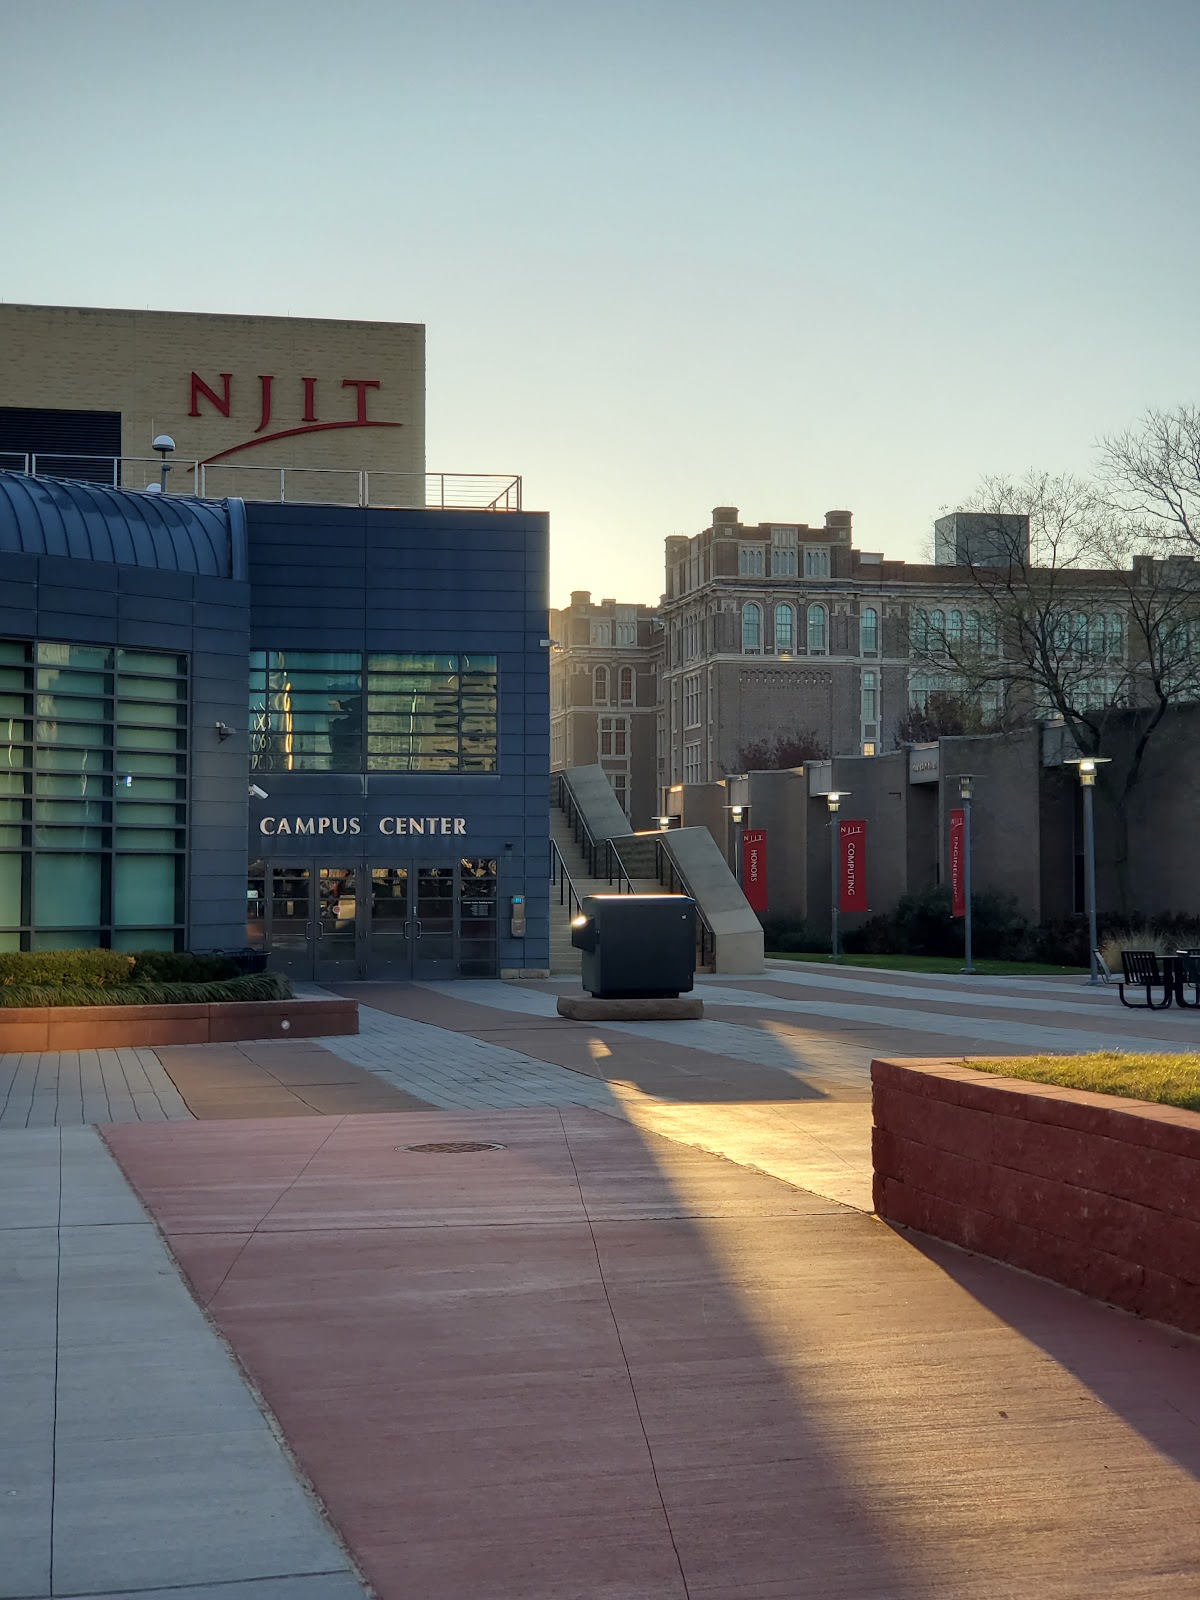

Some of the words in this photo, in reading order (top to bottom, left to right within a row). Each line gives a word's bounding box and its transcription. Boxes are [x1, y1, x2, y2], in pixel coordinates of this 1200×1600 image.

[188, 371, 381, 434] NJIT
[259, 816, 361, 835] CAMPUS
[379, 816, 467, 835] CENTER
[840, 826, 862, 835] NJIT
[750, 849, 758, 882] HONORS
[847, 842, 856, 896] COMPUTING
